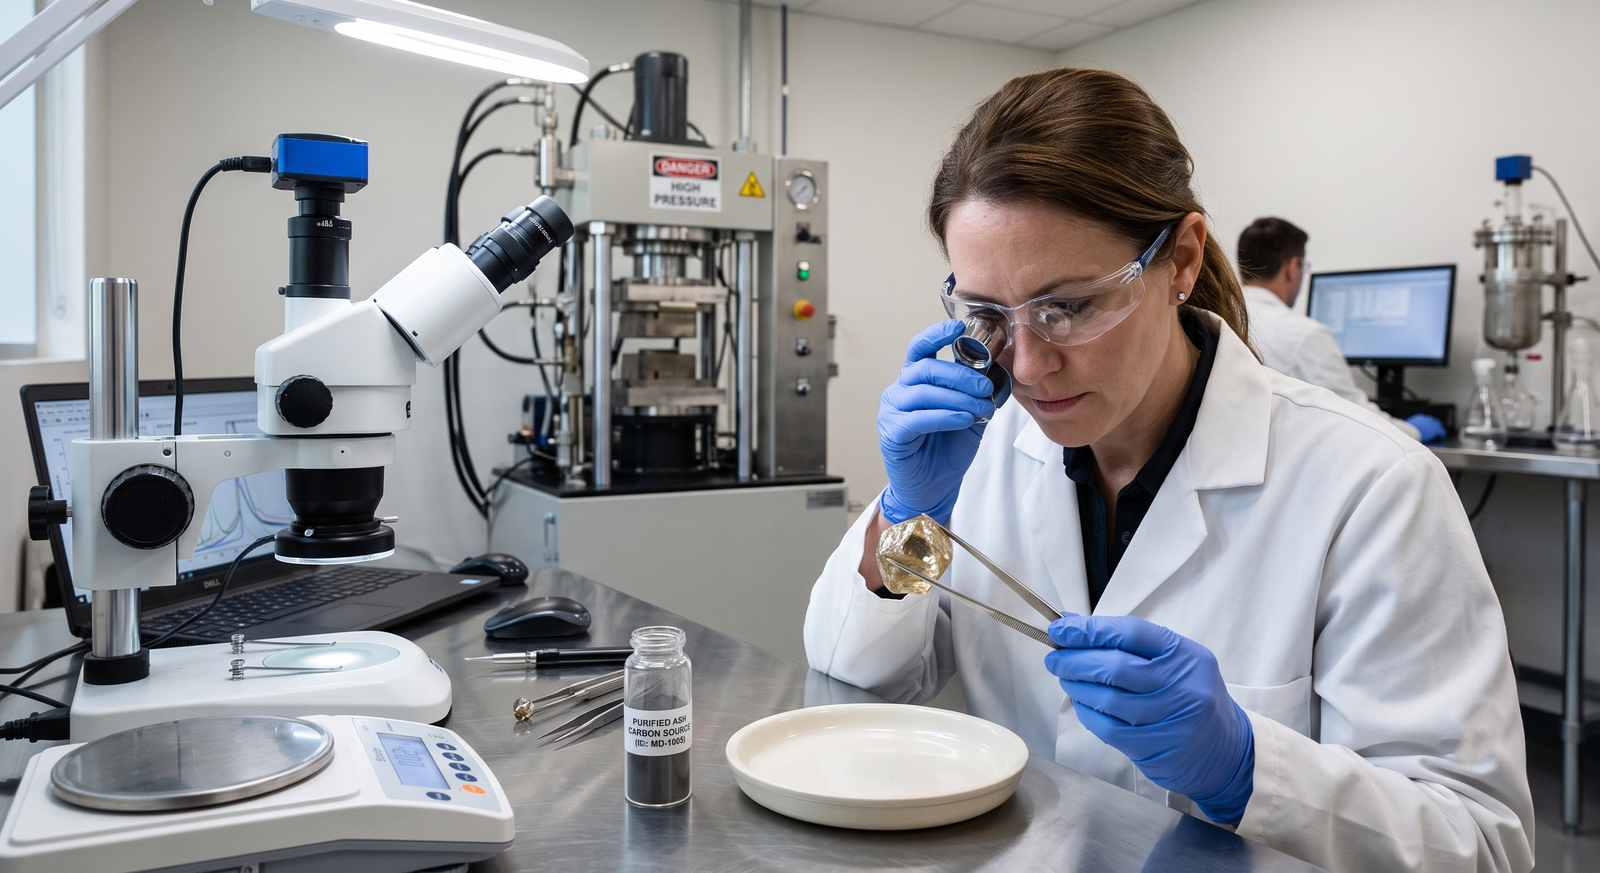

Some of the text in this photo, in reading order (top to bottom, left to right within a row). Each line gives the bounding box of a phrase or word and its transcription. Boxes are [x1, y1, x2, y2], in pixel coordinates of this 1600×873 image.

[660, 160, 711, 175] DANGER
[671, 182, 701, 193] HIGH
[654, 194, 717, 208] PRESSURE
[203, 578, 221, 589] DELL
[632, 715, 687, 727] PURIFIED ASH
[628, 722, 691, 738] CARBON SOURCE
[650, 736, 686, 748] MD-1005)
